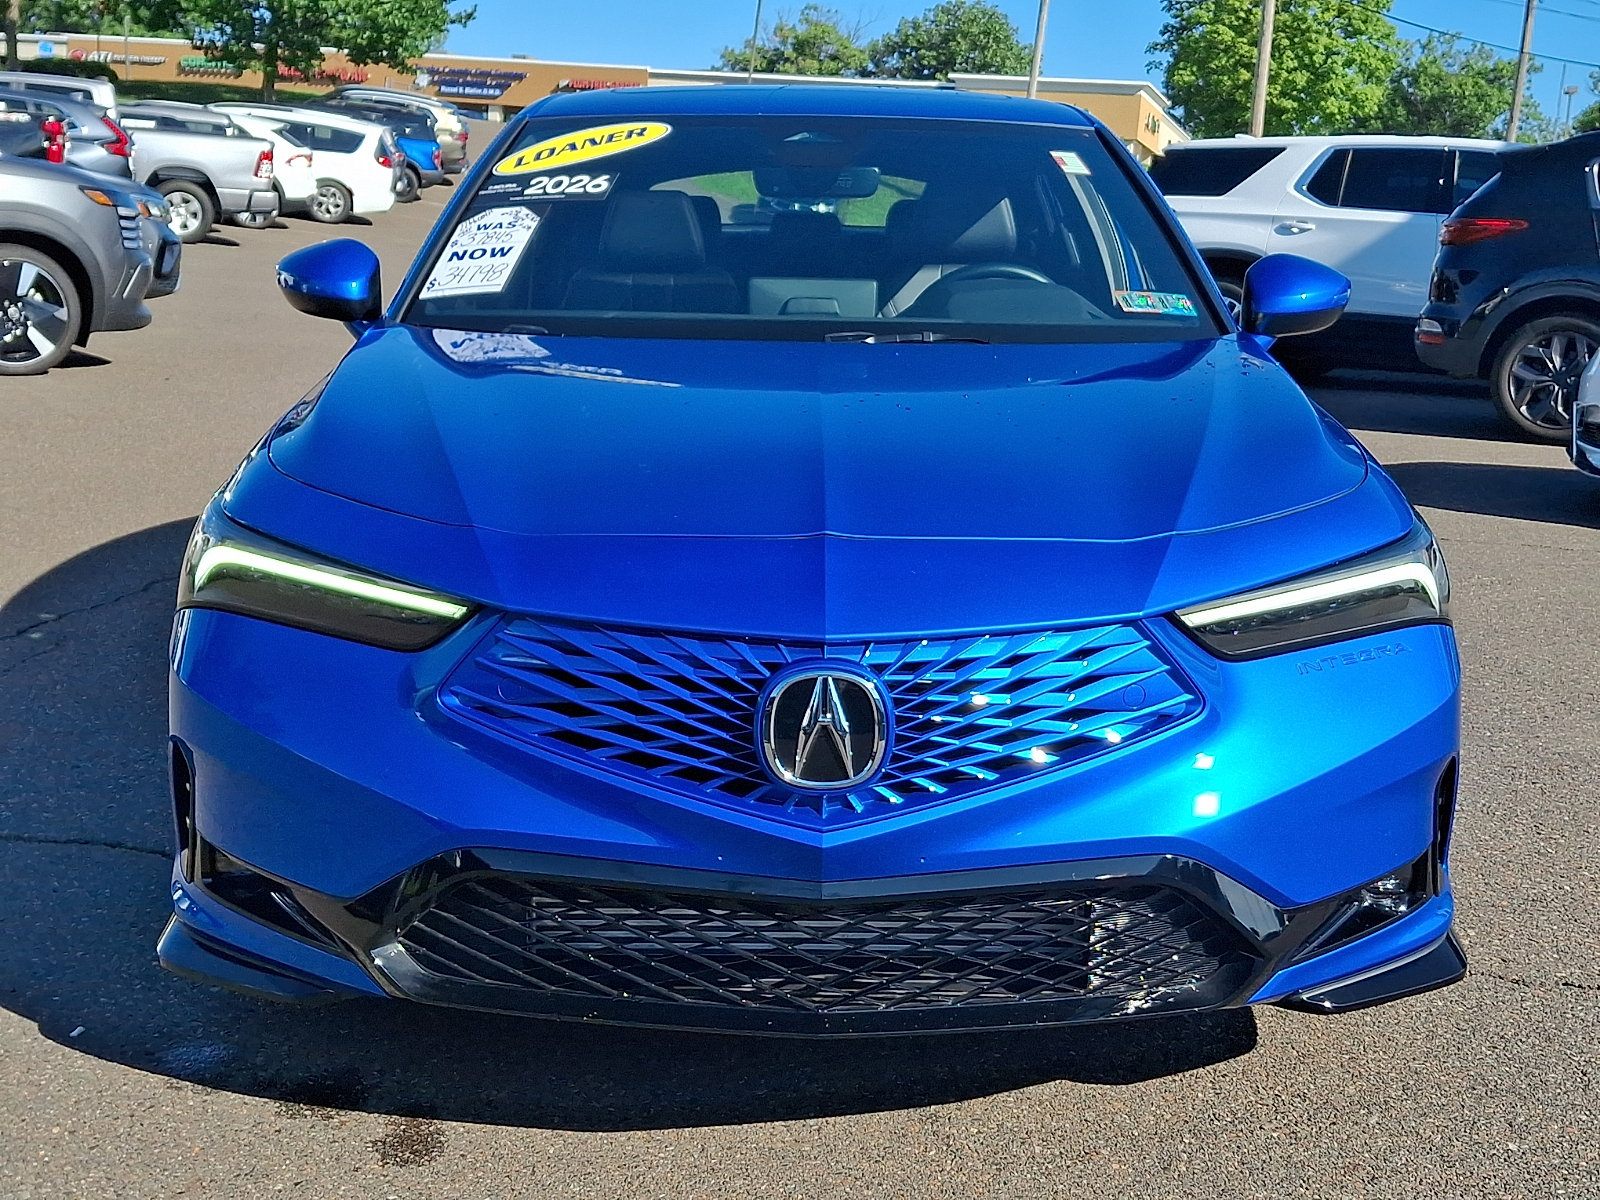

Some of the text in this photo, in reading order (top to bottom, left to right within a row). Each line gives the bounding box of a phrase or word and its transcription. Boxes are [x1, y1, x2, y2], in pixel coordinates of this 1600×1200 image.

[87, 51, 112, 63] ATI
[513, 126, 648, 169] LOANER
[523, 174, 611, 195] 2026
[476, 221, 519, 232] WAS
[446, 245, 515, 263] NOW
[1295, 642, 1413, 675] INTEGRA
